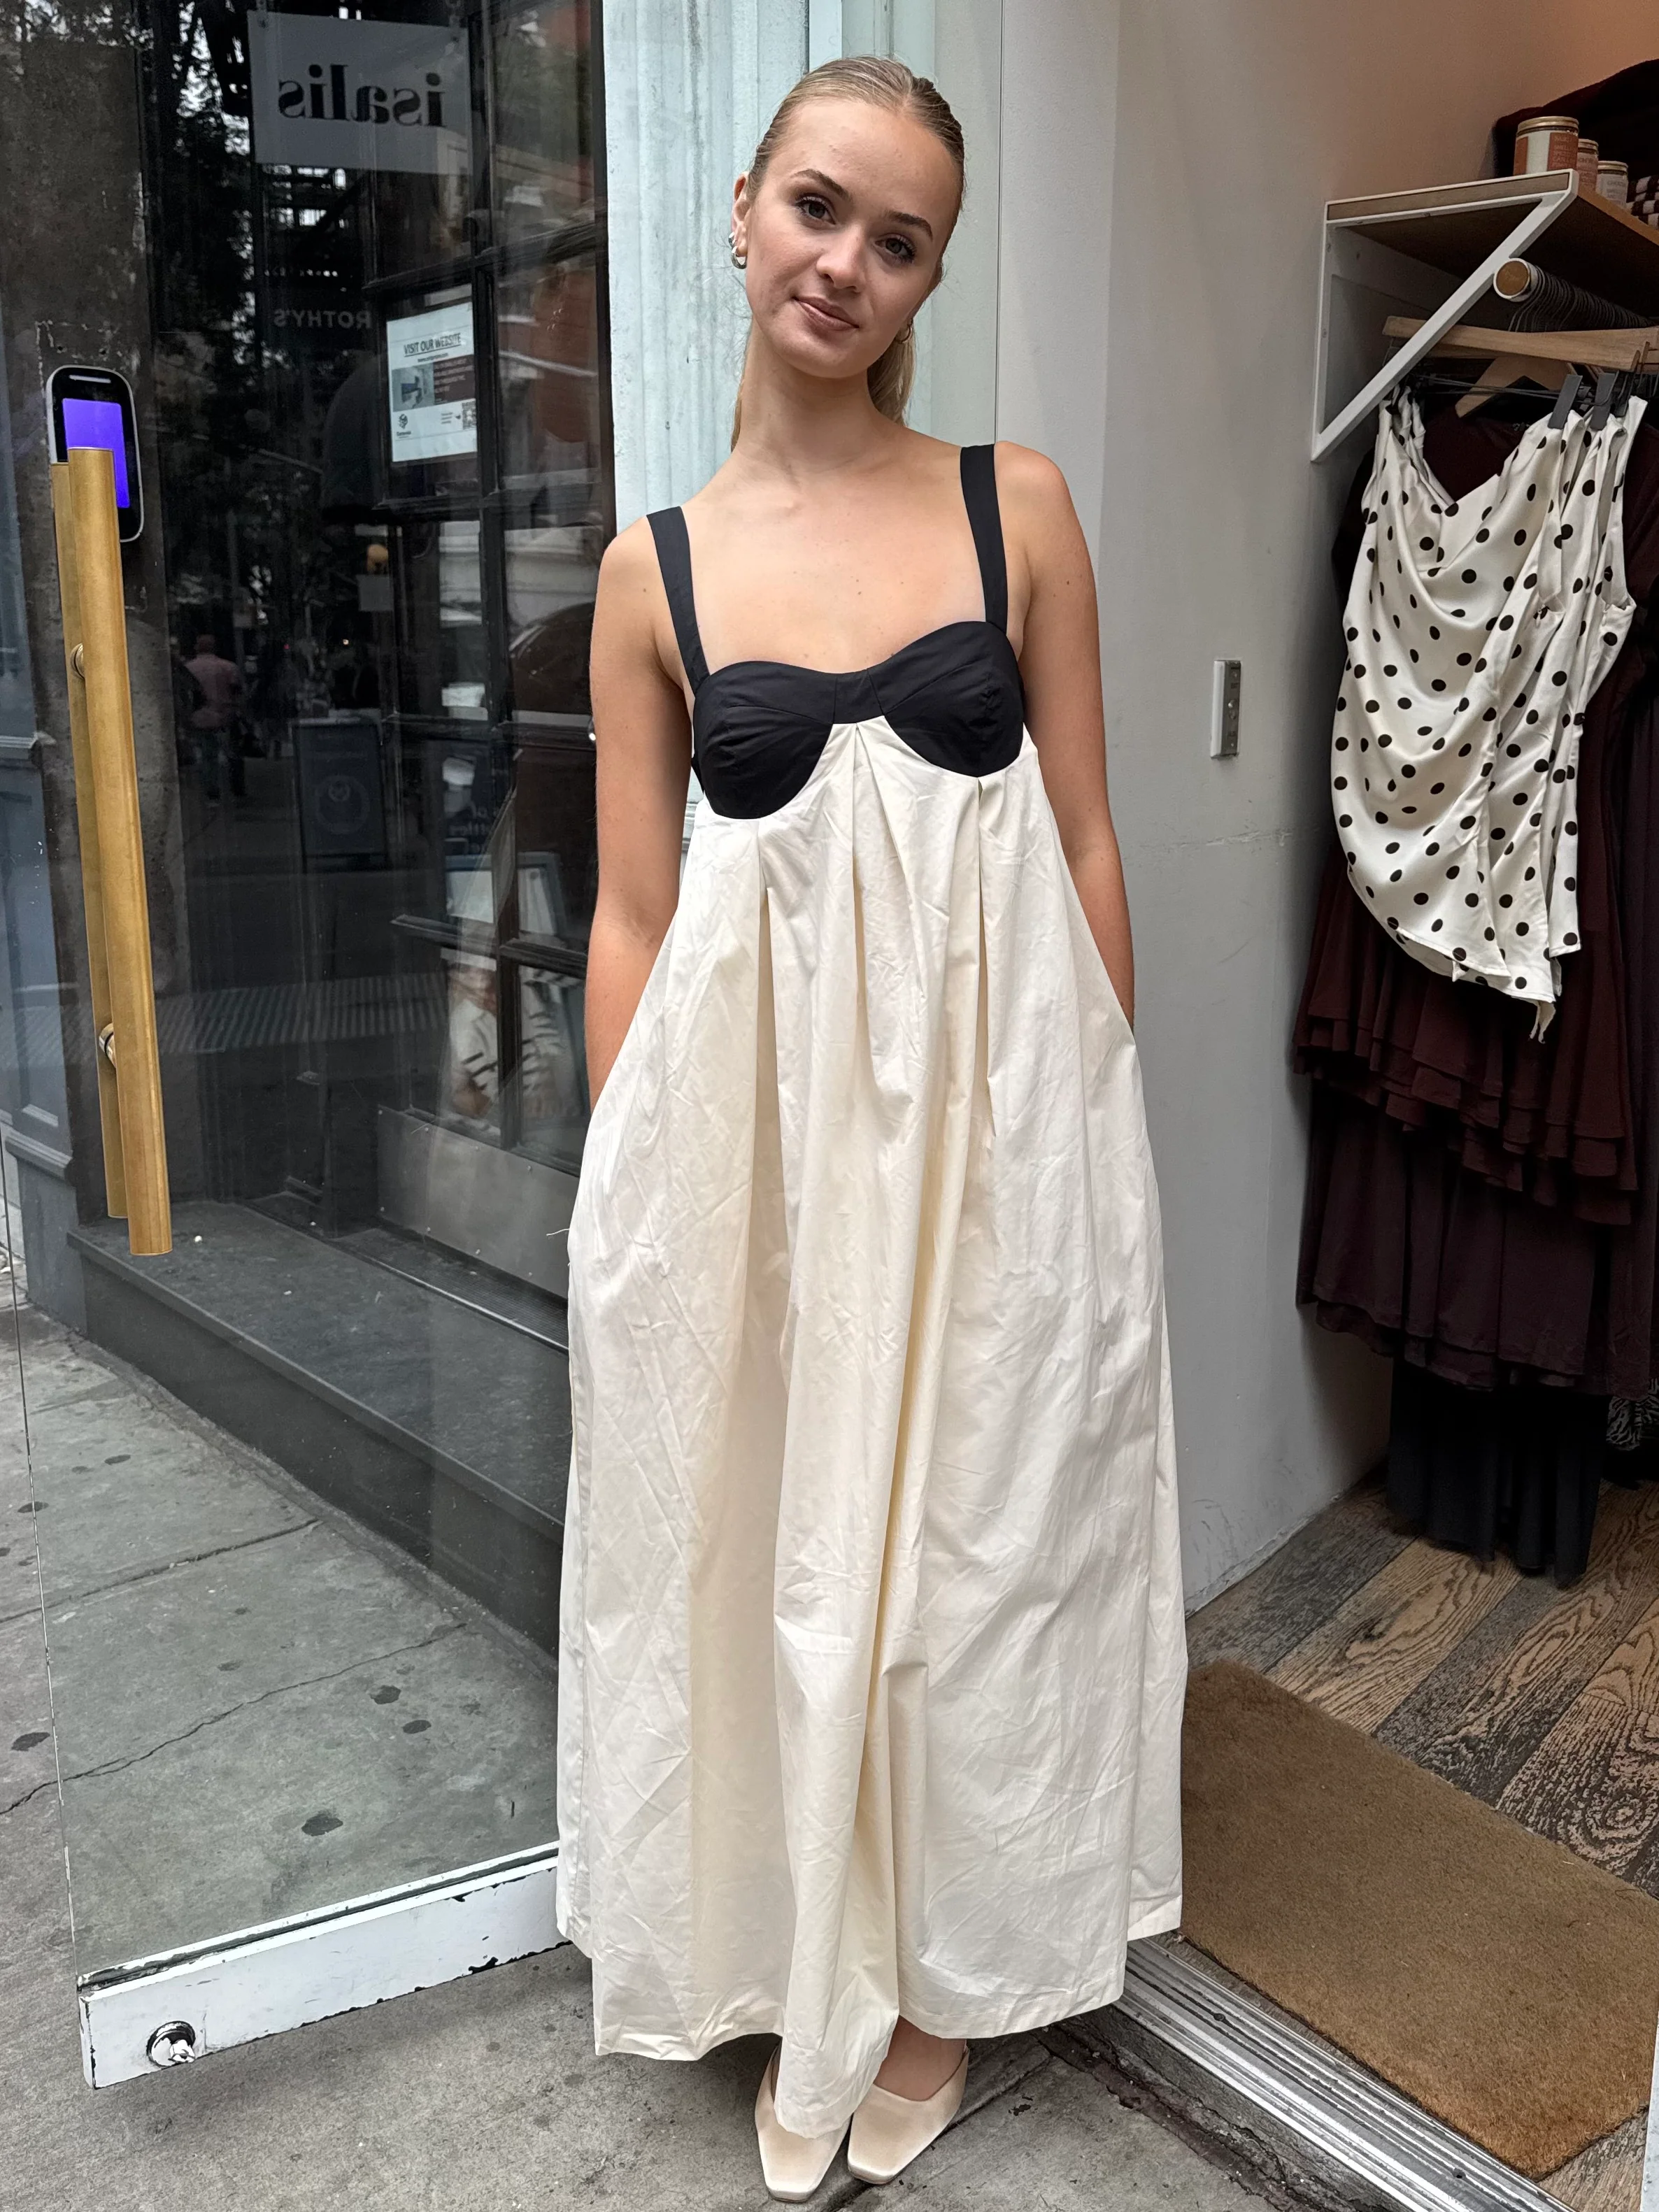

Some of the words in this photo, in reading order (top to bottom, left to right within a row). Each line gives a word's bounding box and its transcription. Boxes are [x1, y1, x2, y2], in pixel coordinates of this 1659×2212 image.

[404, 341, 419, 355] VISIT
[420, 338, 434, 352] OUR
[434, 333, 461, 348] WEBSITE
